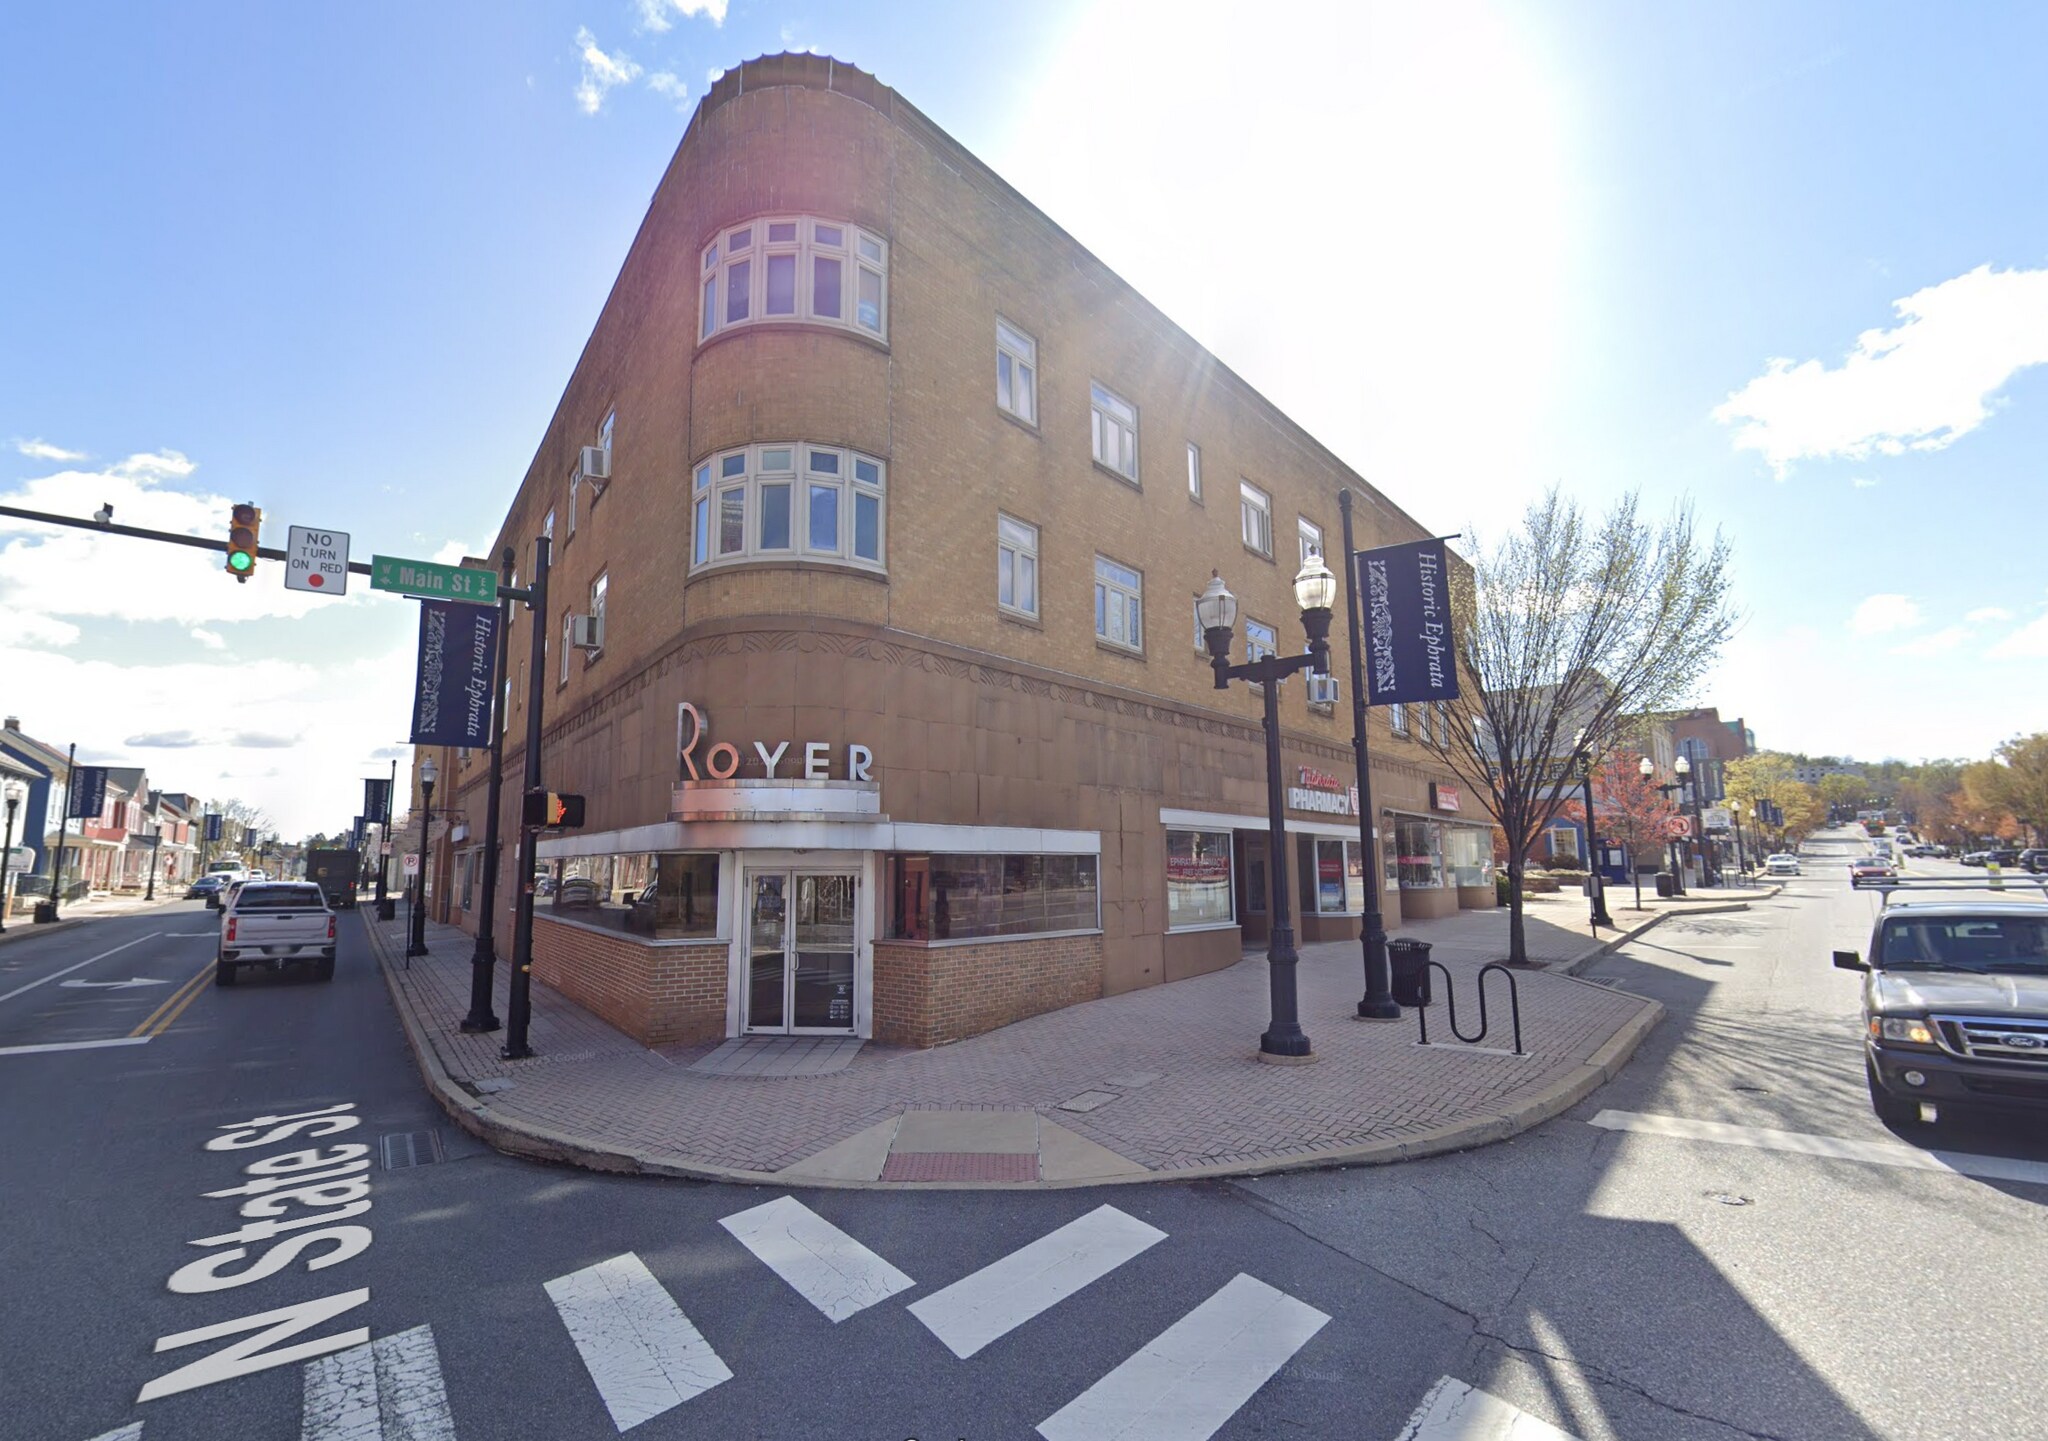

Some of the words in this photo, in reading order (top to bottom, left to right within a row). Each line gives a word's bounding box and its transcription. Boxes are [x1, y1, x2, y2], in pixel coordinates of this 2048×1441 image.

[301, 547, 337, 560] TURN
[306, 533, 332, 547] NO
[292, 559, 309, 570] ON
[320, 562, 343, 574] RED
[400, 566, 444, 590] Main
[452, 573, 471, 594] St
[1419, 552, 1440, 618] Historic
[472, 615, 492, 674] Historic
[1420, 621, 1445, 688] Ephrata
[464, 677, 487, 737] Ephrata
[1288, 787, 1350, 815] PHARMACY
[2008, 1037, 2034, 1047] Ford
